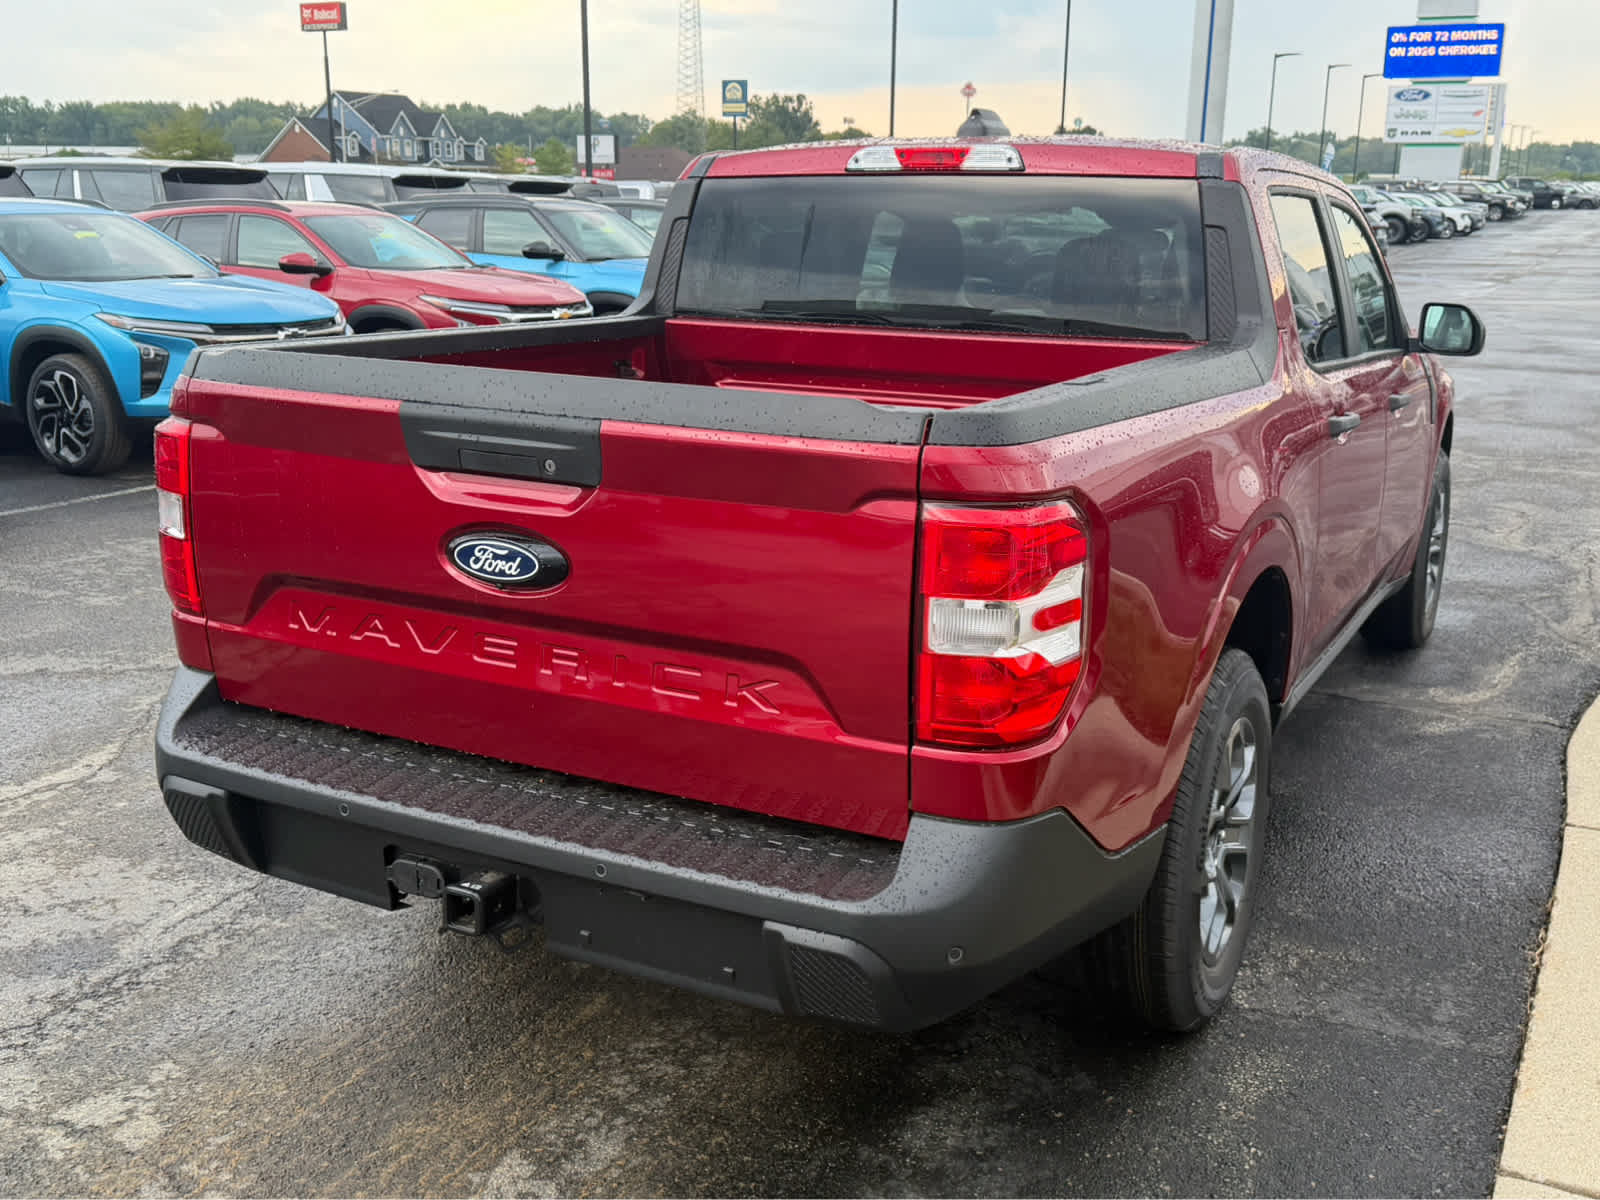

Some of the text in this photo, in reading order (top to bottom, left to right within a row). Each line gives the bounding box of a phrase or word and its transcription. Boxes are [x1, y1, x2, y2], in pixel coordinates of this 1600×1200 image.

[313, 8, 338, 20] Bobcat
[1391, 29, 1499, 43] 0% FOR 72 MONTHS
[1389, 44, 1498, 57] ON 2026 CHEROKEE
[469, 545, 523, 575] Ford
[287, 604, 781, 715] MAVERICK
